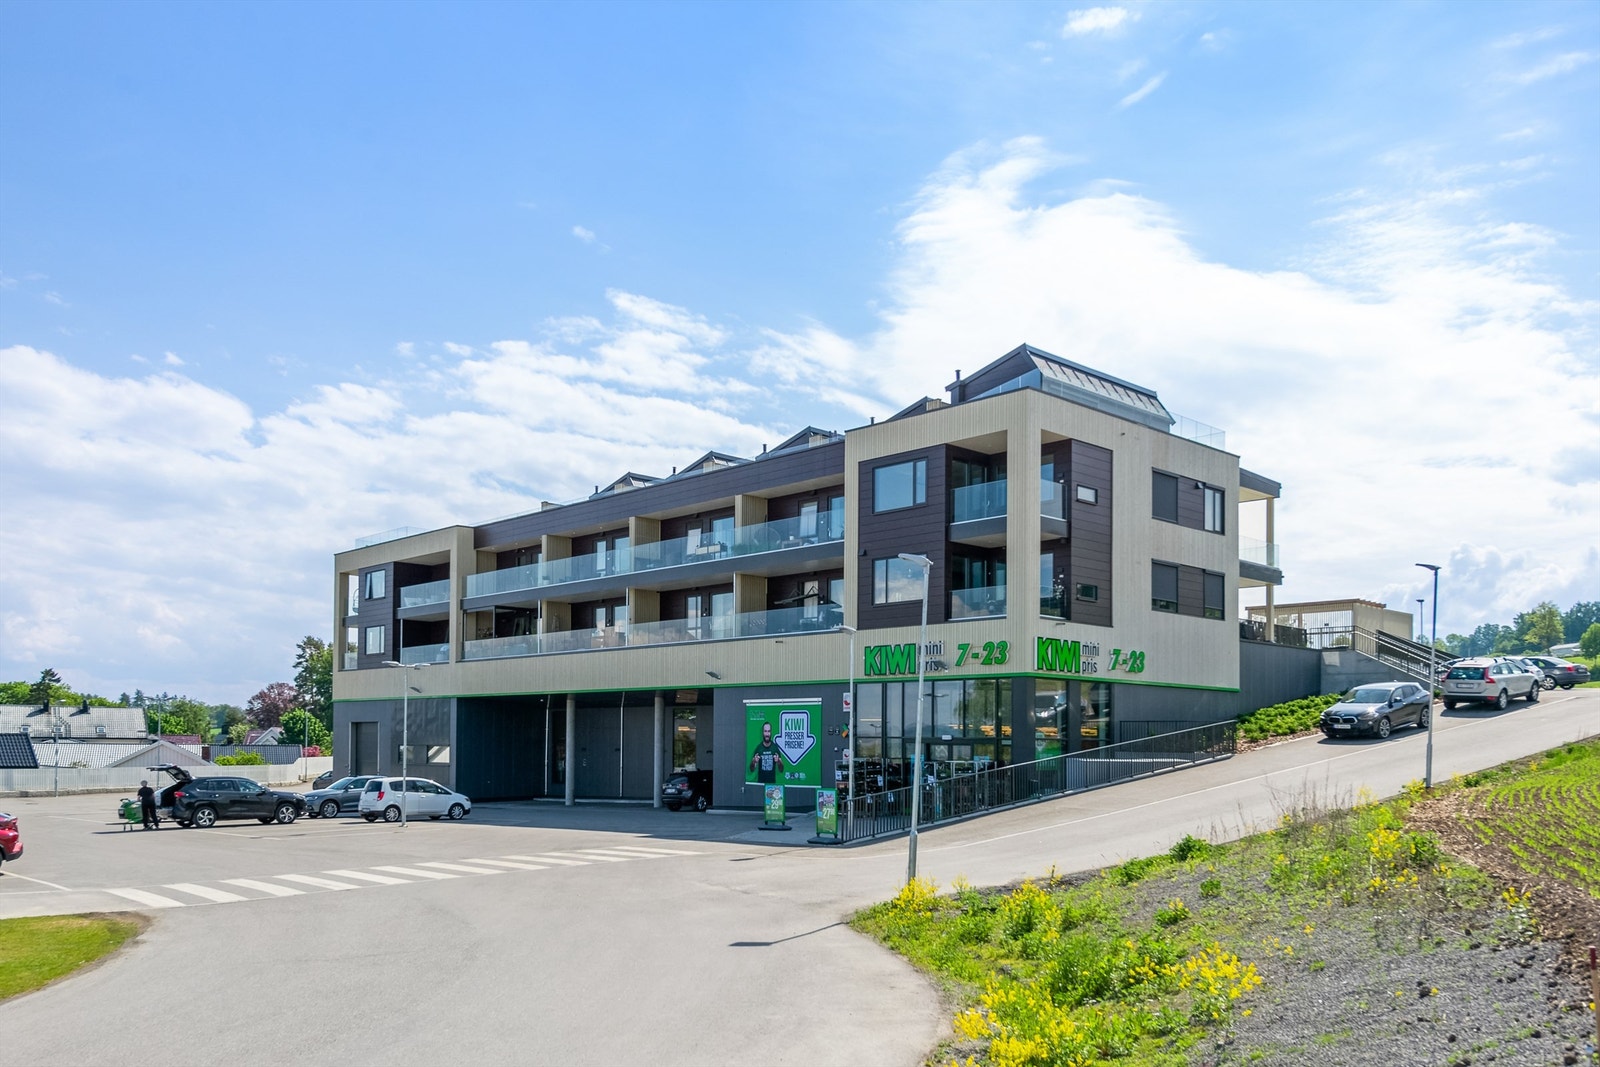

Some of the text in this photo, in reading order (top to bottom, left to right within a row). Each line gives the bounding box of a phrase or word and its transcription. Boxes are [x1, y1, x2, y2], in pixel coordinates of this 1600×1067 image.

[955, 640, 1010, 666] 7-23
[1035, 636, 1081, 673] KIWI
[1082, 642, 1099, 656] mini
[864, 643, 917, 676] KIWI
[1082, 658, 1098, 674] pris
[1108, 648, 1146, 673] 7-23
[784, 718, 805, 731] KIWI
[784, 731, 805, 740] PRESSER
[784, 741, 805, 749] PRISENE!
